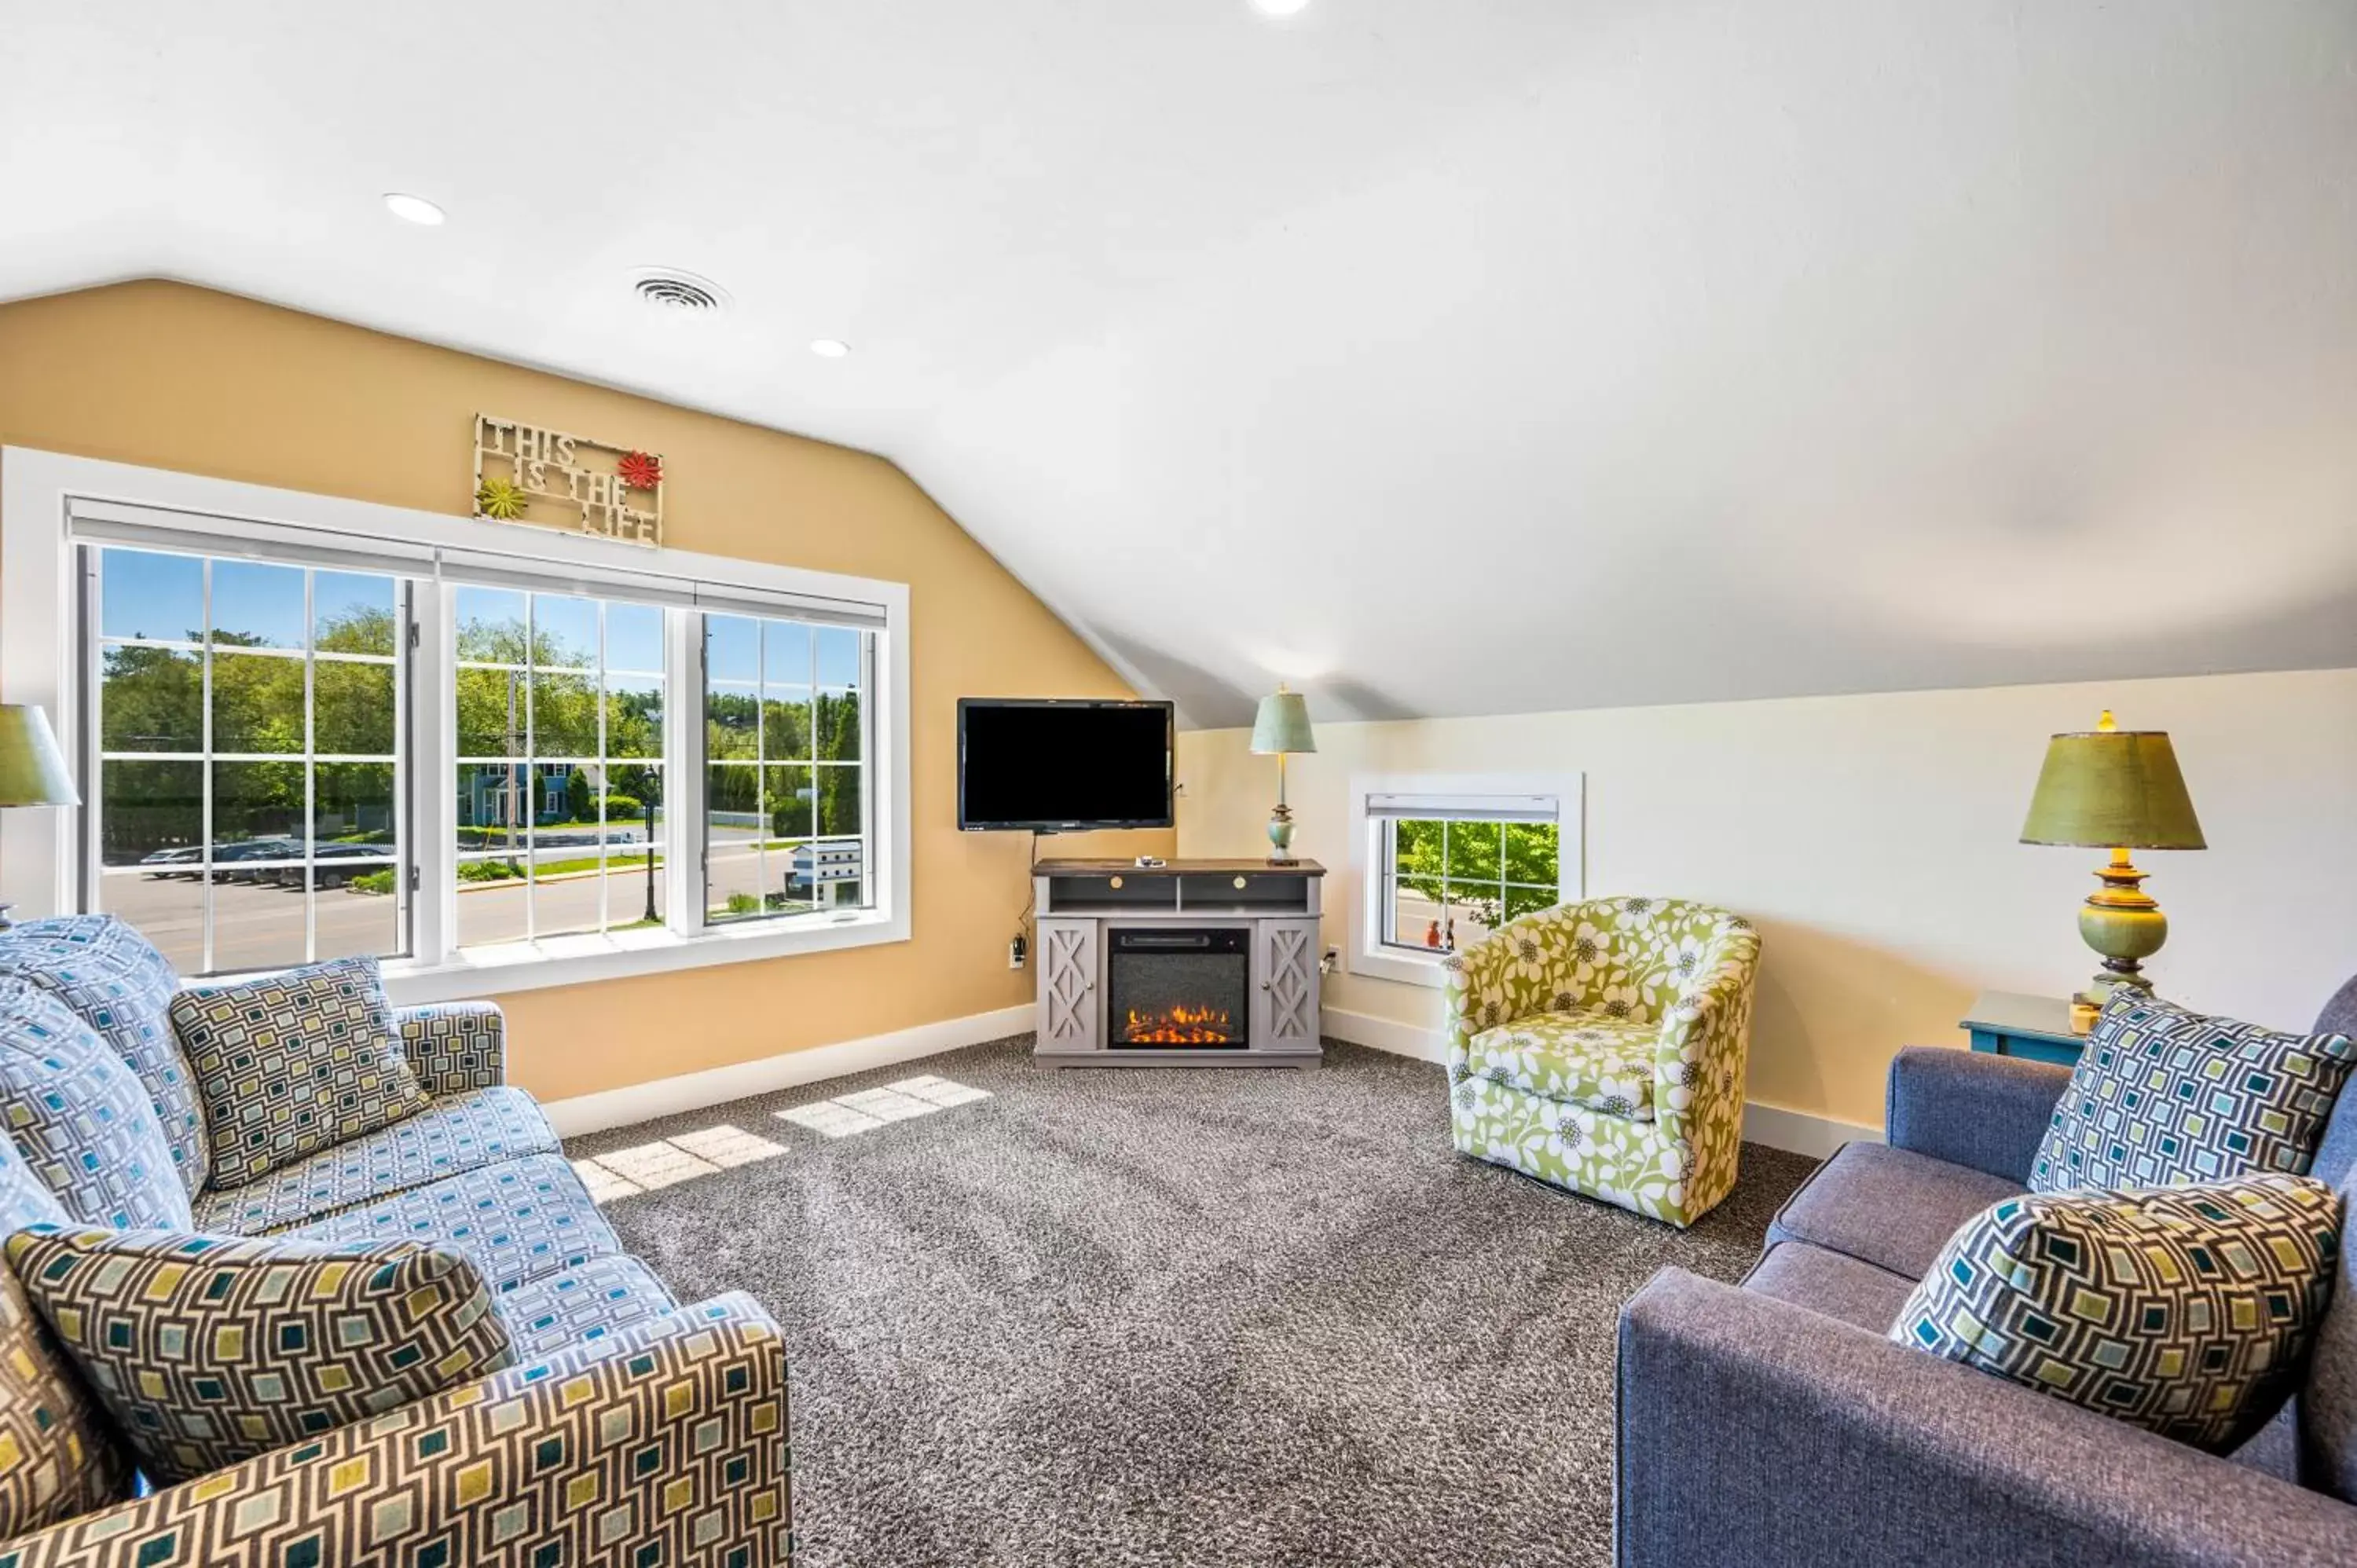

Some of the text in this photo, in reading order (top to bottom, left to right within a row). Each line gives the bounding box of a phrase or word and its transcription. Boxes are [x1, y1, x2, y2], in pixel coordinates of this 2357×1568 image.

[486, 419, 576, 467] THIS
[514, 455, 631, 507] IS THE
[582, 500, 658, 548] LIFE
